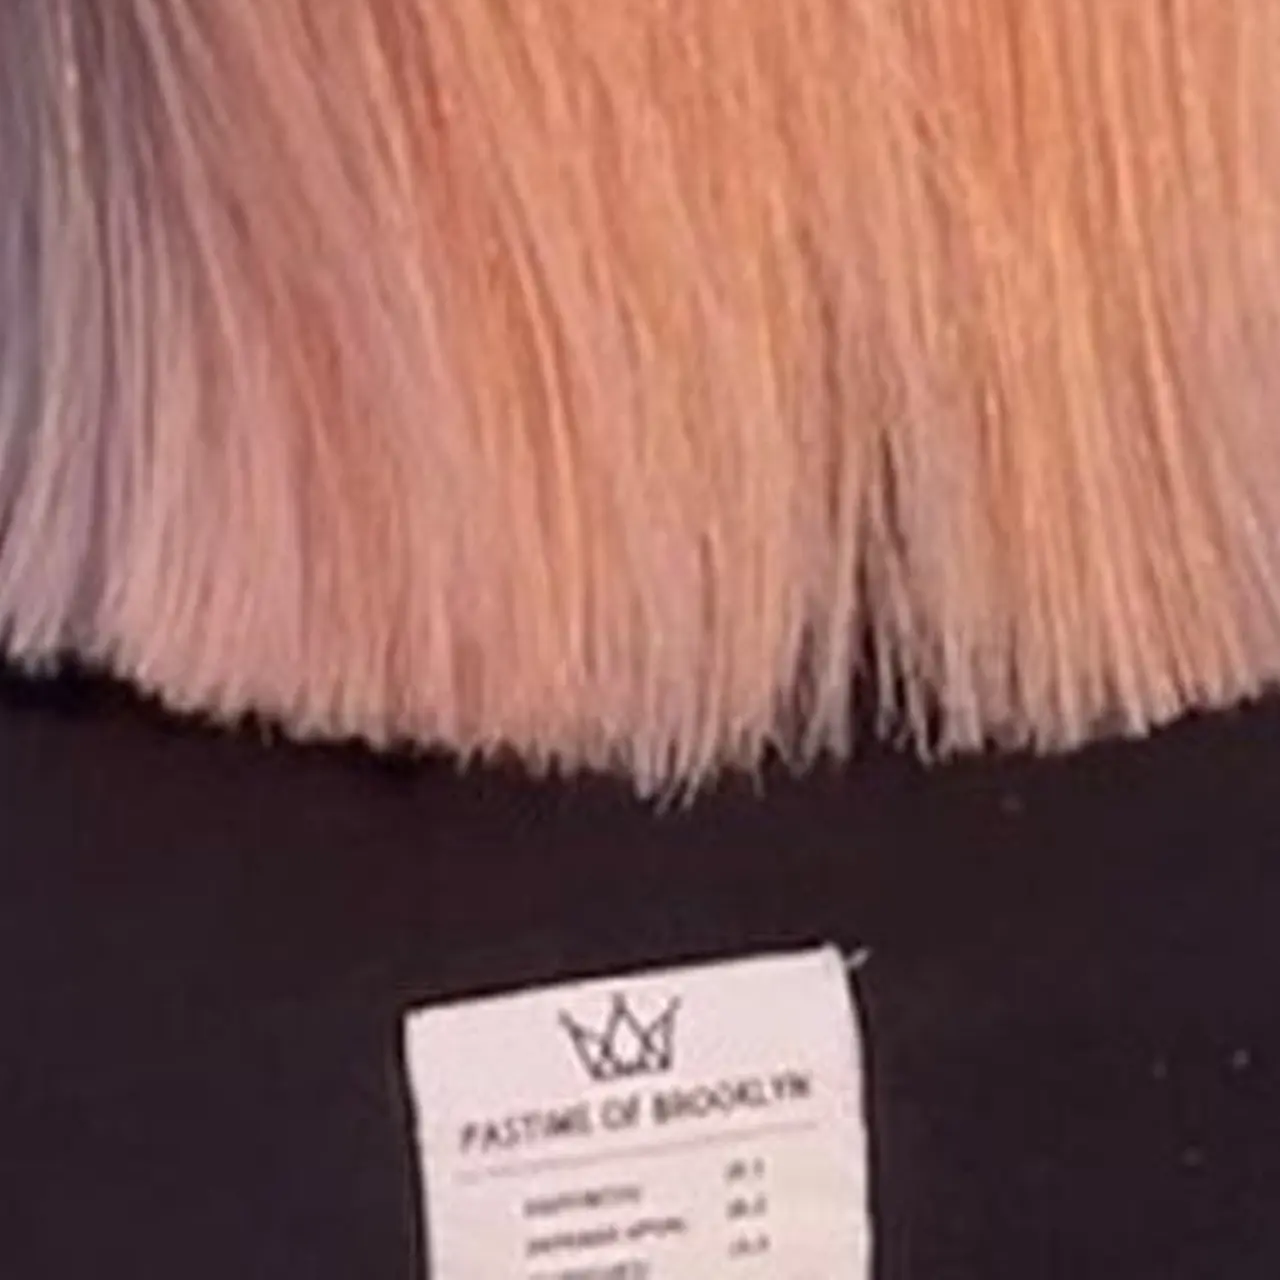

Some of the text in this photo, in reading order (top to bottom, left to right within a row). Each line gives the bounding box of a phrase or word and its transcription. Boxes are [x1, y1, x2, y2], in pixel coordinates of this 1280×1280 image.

[460, 1072, 810, 1152] PASTIME OF BROOKLYN
